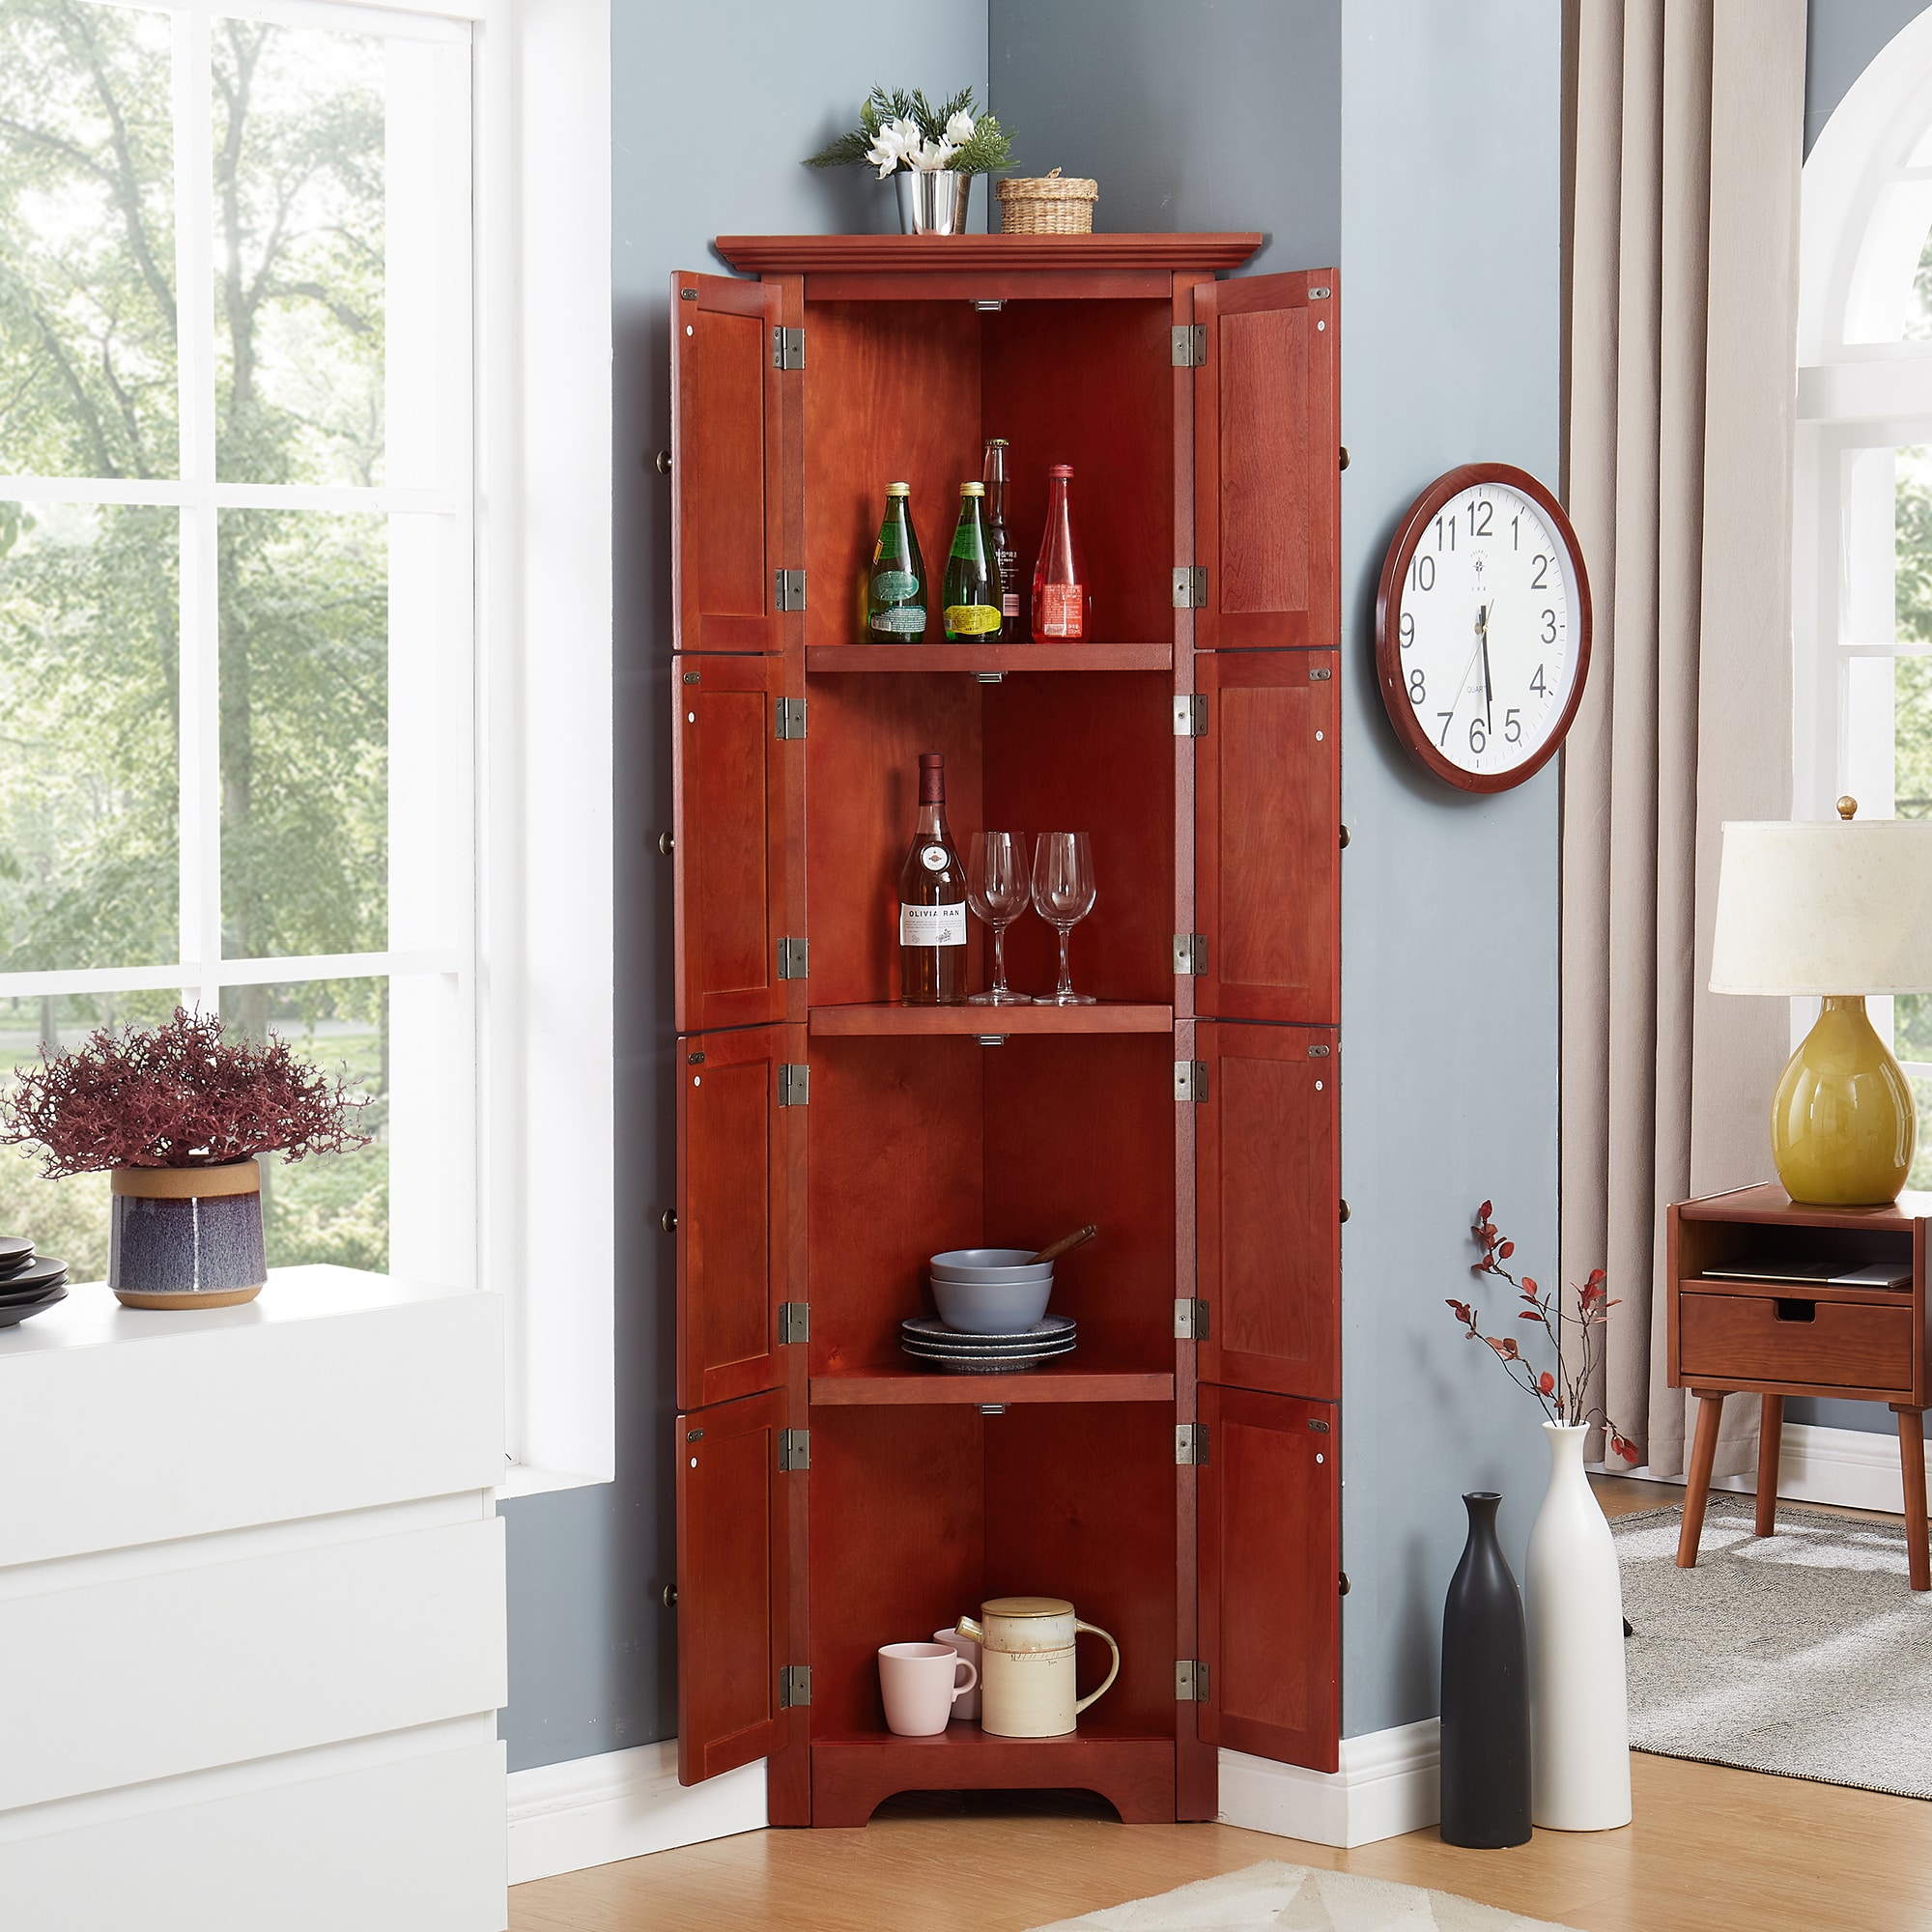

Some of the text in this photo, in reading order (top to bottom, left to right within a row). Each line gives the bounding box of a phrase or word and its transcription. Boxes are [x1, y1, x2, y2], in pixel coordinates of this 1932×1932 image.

[1435, 516, 1456, 551] 11
[1467, 501, 1492, 536] 12
[1511, 516, 1519, 551] 1
[1410, 555, 1435, 591] 10
[1531, 554, 1548, 589] 2
[1401, 612, 1414, 648] 9
[1541, 610, 1556, 643] 3
[1409, 668, 1426, 704] 8
[1529, 664, 1546, 698] 4
[1437, 712, 1454, 747] 7
[1469, 719, 1486, 753] 6
[1504, 709, 1520, 742] 5
